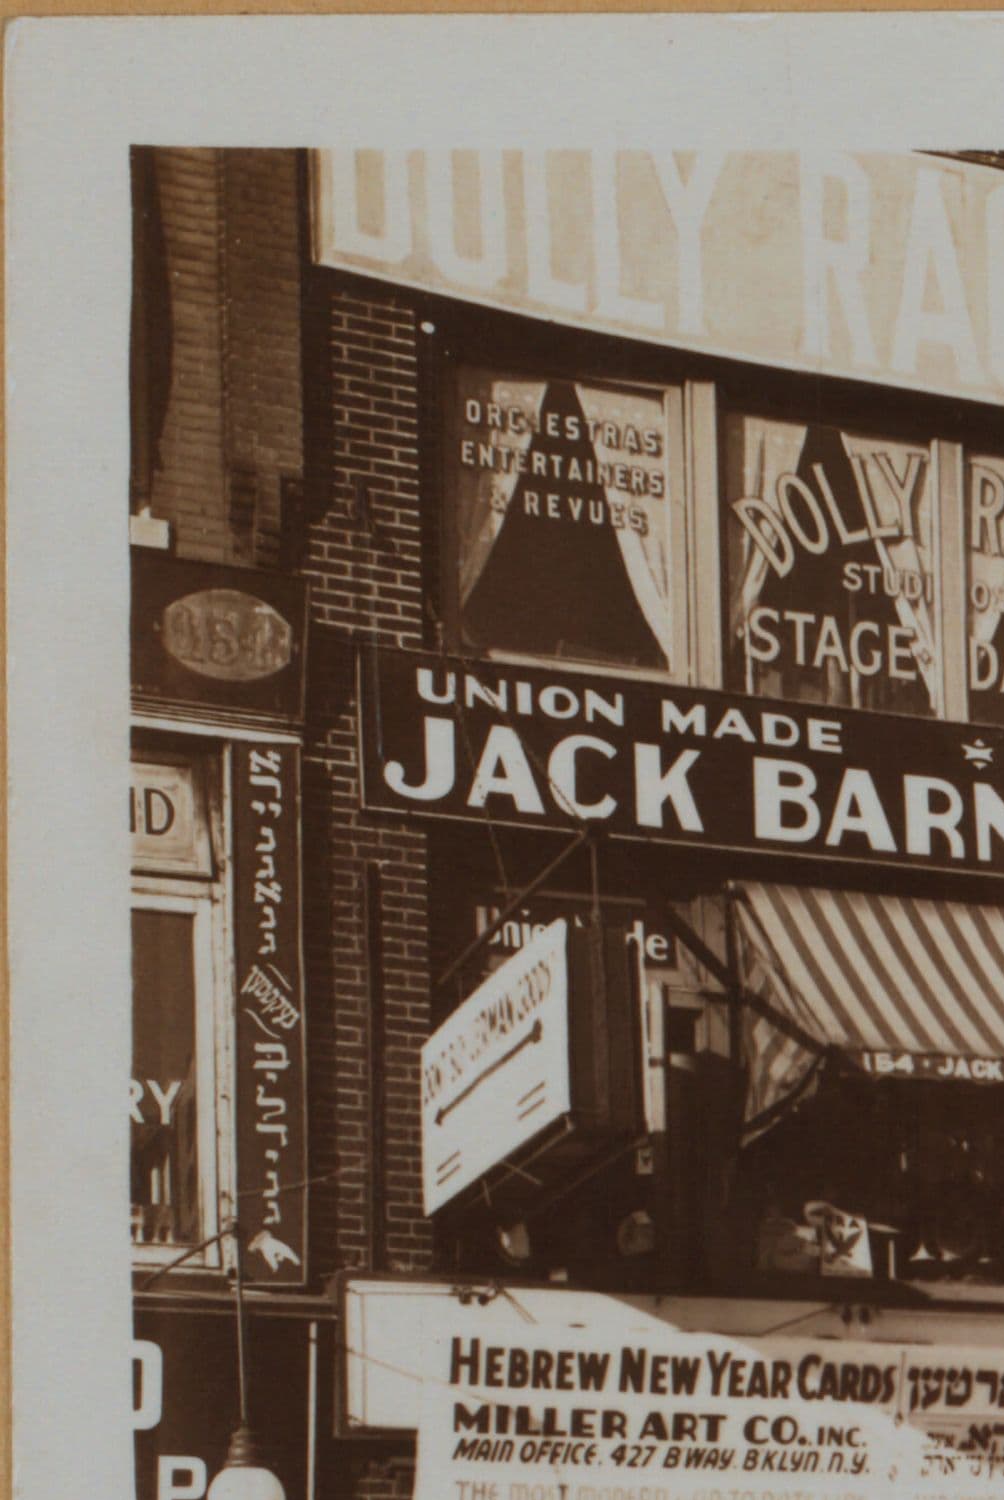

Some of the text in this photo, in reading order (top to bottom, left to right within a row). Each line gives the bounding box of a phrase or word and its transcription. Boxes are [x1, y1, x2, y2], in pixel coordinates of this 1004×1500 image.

[461, 440, 664, 498] ENTERTAINERS
[524, 491, 647, 536] REVUES
[733, 450, 930, 578] DOLLY
[748, 606, 918, 681] STAGE
[417, 668, 843, 754] UNION MADE
[384, 716, 704, 832] JACK
[130, 786, 175, 836] D
[938, 1058, 1001, 1081] JACK
[449, 1337, 897, 1404] HEBREW NEW YEAR CARDS
[452, 1402, 628, 1442] MILLER
[638, 1411, 728, 1443] ART
[817, 1426, 868, 1448] INC.
[452, 1437, 516, 1464] MAIN
[610, 1445, 658, 1468] 427
